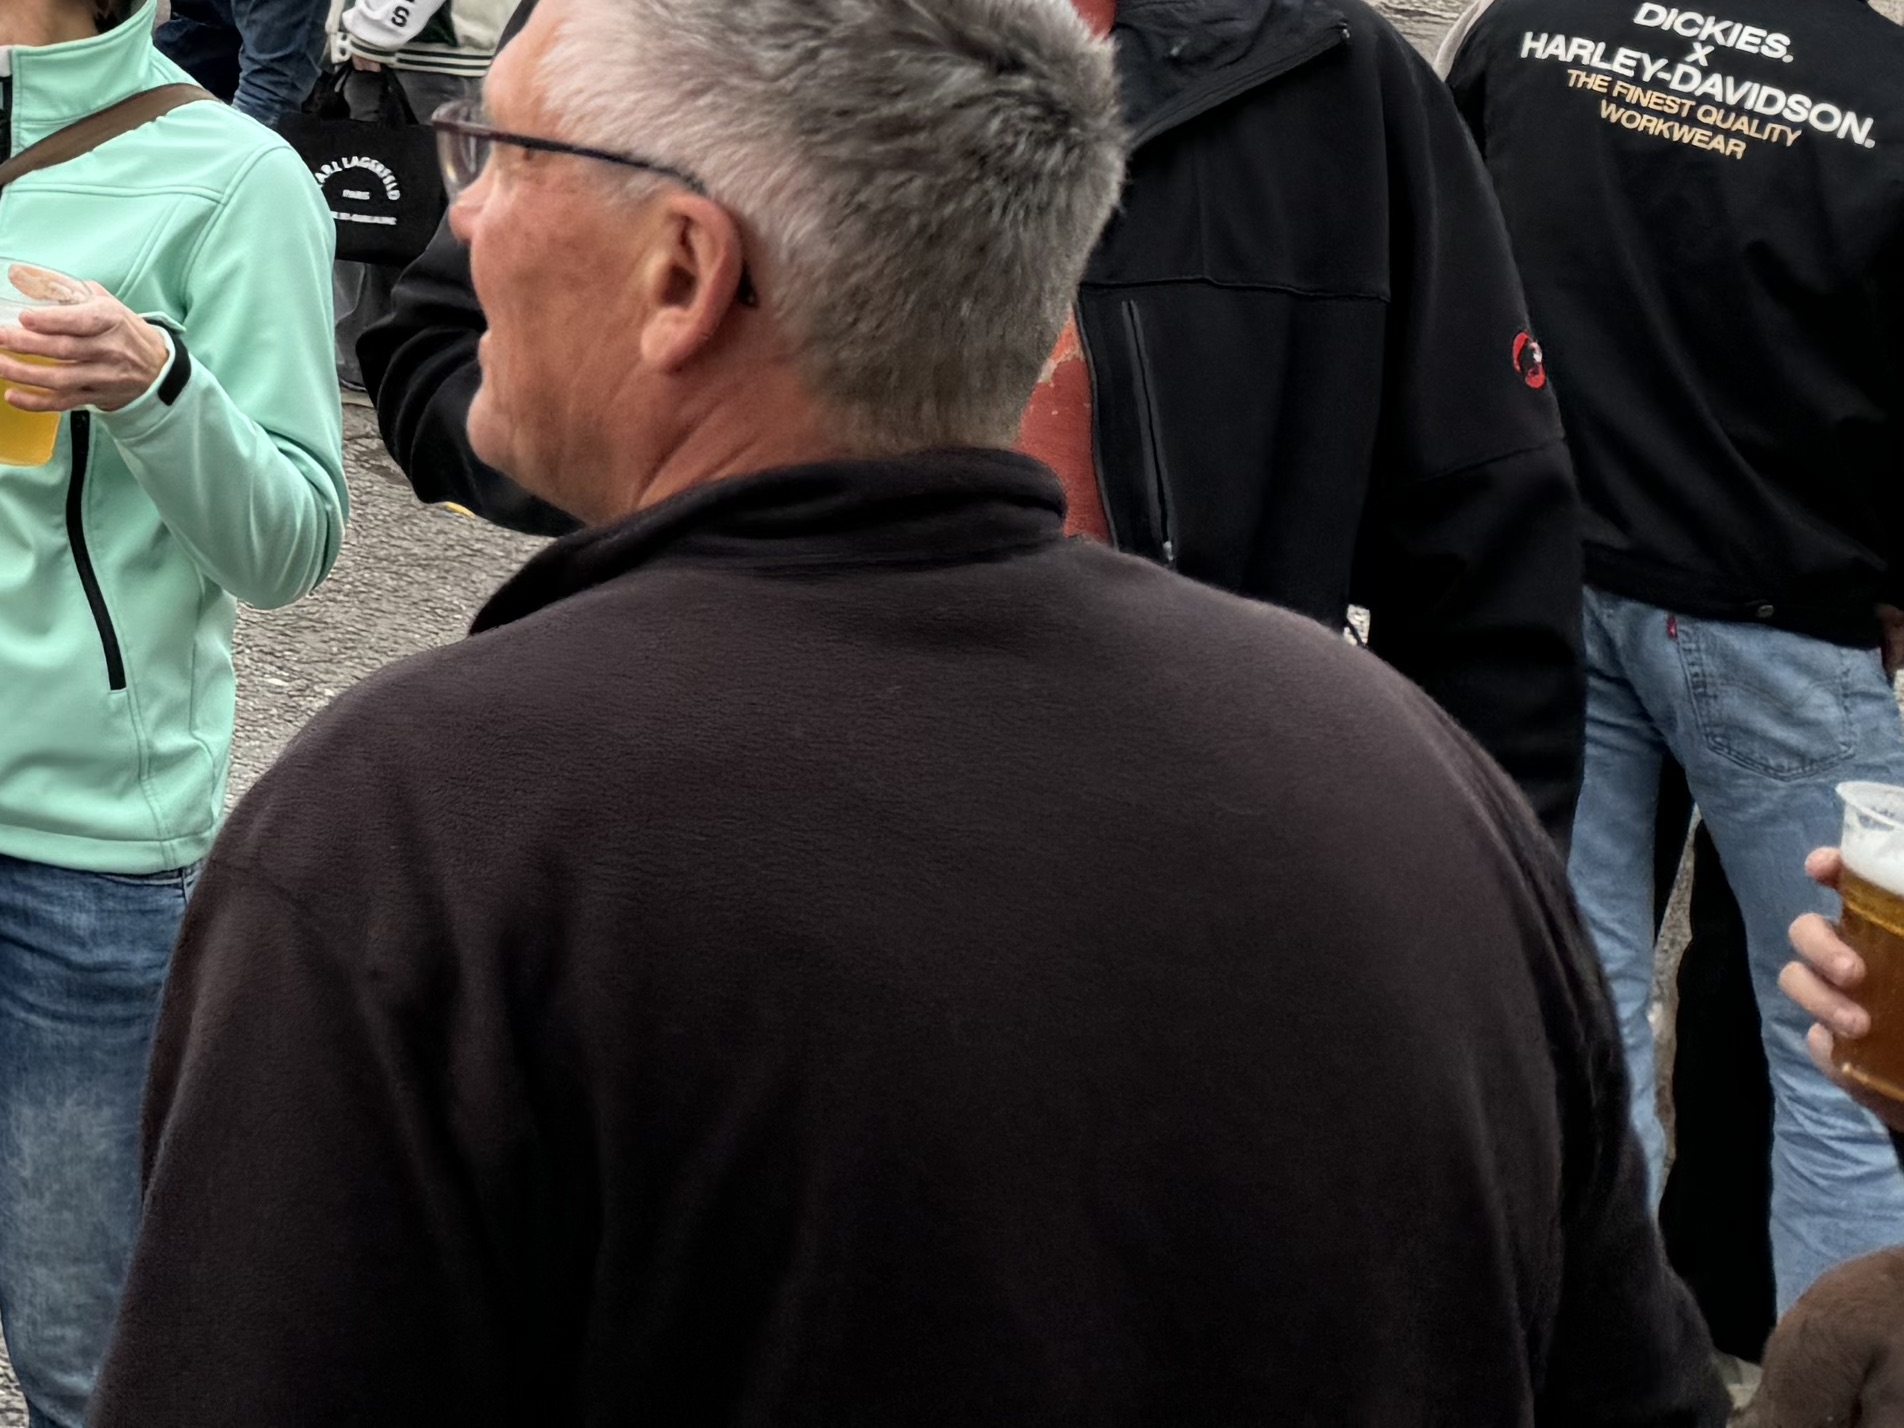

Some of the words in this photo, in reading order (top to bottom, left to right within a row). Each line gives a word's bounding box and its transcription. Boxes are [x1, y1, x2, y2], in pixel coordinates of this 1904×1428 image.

[1566, 69, 1610, 94] THE
[1612, 82, 1696, 119] FINEST
[1696, 106, 1803, 148] QUALITY
[1599, 98, 1748, 161] WORKWEAR
[314, 160, 343, 187] ARL
